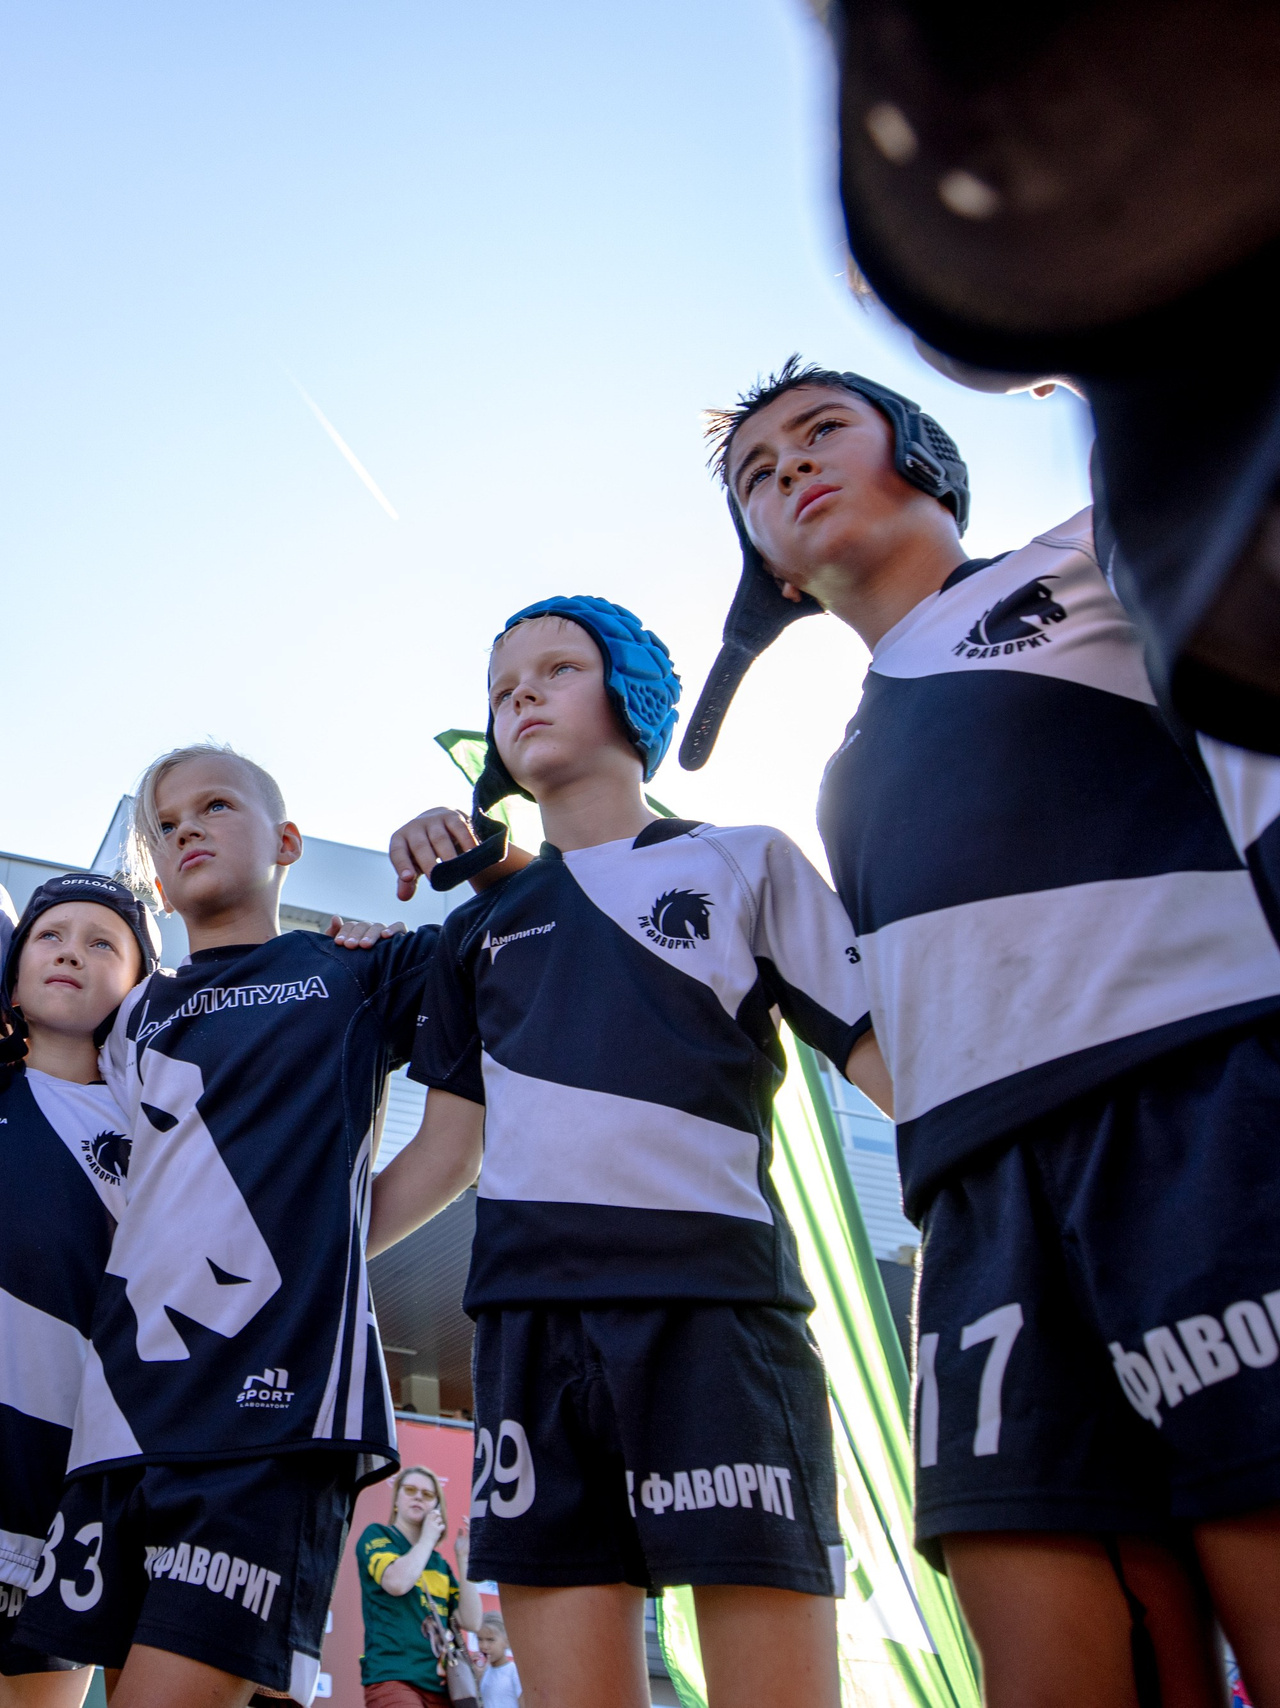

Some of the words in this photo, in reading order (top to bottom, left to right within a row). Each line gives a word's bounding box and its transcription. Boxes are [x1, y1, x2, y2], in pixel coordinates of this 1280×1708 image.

[966, 632, 1052, 660] ФАВОРИТ
[61, 879, 117, 892] OFFLOAD
[491, 921, 557, 946] АМПЛИТУДА
[638, 916, 651, 928] РК
[646, 929, 697, 950] ФАВОРИТ
[81, 1140, 91, 1152] РК
[85, 1154, 121, 1187] ФАВОРИТ
[236, 1389, 295, 1403] SPORT
[919, 1302, 1024, 1469] 17
[470, 1419, 537, 1519] 29
[640, 1463, 796, 1521] ФАВОРИТ
[152, 1541, 282, 1622] ФАВОРИТ
